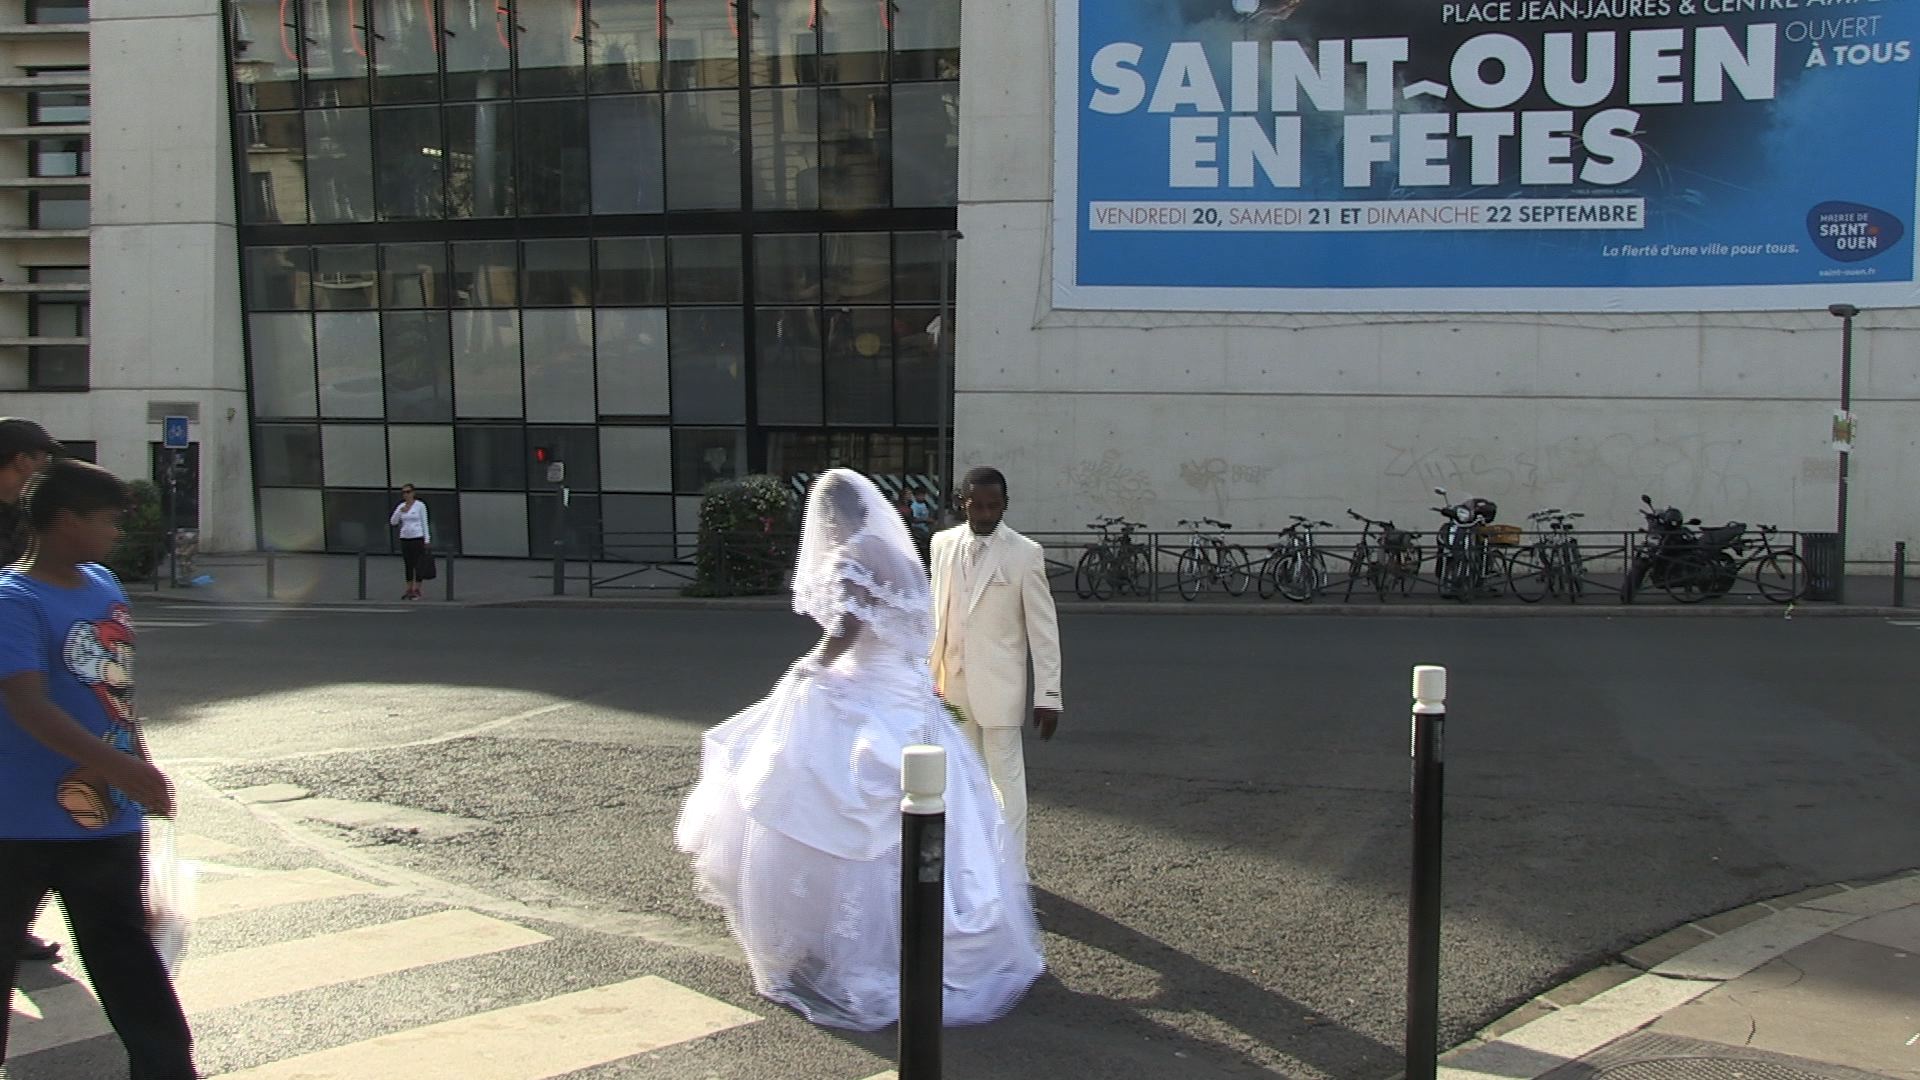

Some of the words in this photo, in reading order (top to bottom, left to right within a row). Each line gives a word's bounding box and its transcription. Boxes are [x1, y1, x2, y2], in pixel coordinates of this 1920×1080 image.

[1443, 3, 1511, 23] PLACE
[1785, 15, 1881, 42] OUVERT
[1805, 42, 1827, 67] À
[1832, 41, 1910, 66] TOUS
[1169, 115, 1301, 188] EN
[1095, 207, 1187, 225] VENDREDI
[1192, 207, 1224, 228] 20,
[1229, 207, 1302, 225] SAMEDI
[1308, 207, 1331, 225] 21
[1340, 207, 1362, 225] ET
[1367, 205, 1480, 225] DIMANCHE
[1486, 205, 1512, 224] 22
[1519, 204, 1638, 223] SEPTEMBRE
[1820, 213, 1854, 222] MAIRIE
[1856, 212, 1869, 222] DE
[1819, 222, 1868, 236] SAINT
[1602, 244, 1619, 256] La
[1621, 244, 1658, 257] fierté
[1660, 244, 1699, 256] d'une
[1700, 242, 1729, 255] ville
[1730, 244, 1763, 257] pour
[1765, 242, 1800, 254] tous.
[1836, 236, 1878, 250] OUEN
